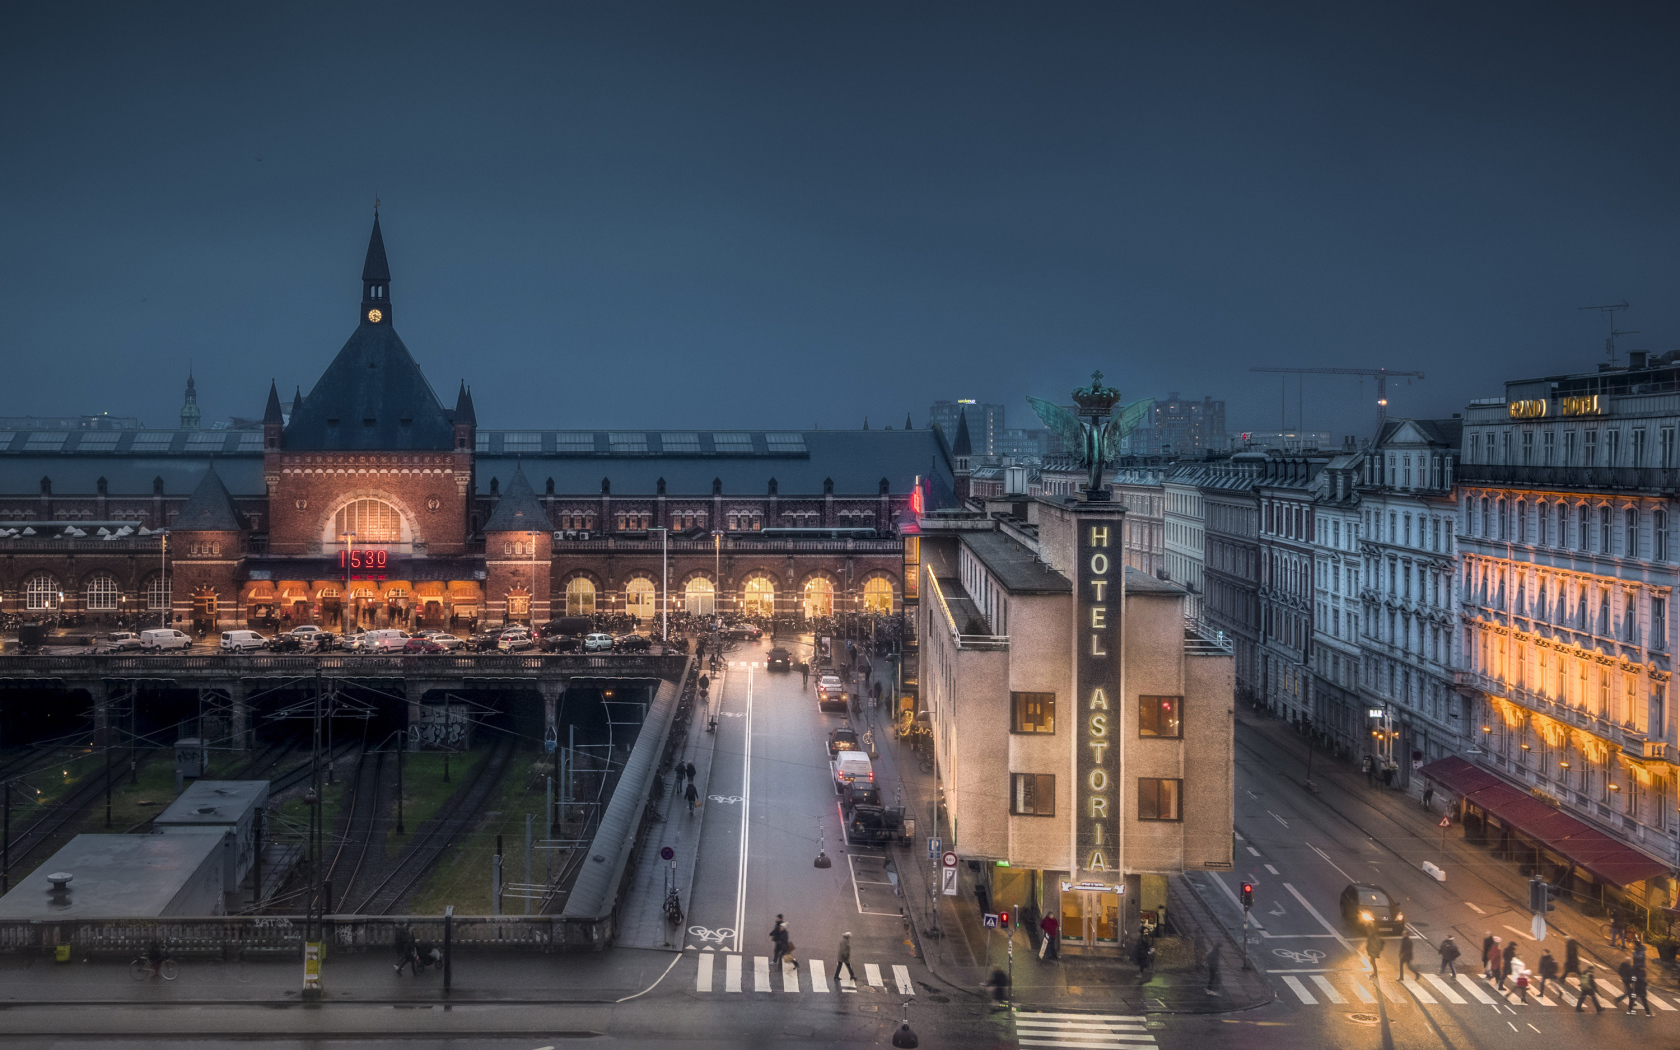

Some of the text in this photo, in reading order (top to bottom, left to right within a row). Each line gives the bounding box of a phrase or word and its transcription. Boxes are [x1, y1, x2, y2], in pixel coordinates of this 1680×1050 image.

[1509, 395, 1601, 418] GRAND HOTEL
[1091, 526, 1108, 656] HOTEL
[1369, 709, 1383, 718] BAR
[1090, 688, 1108, 871] ASTORIA
